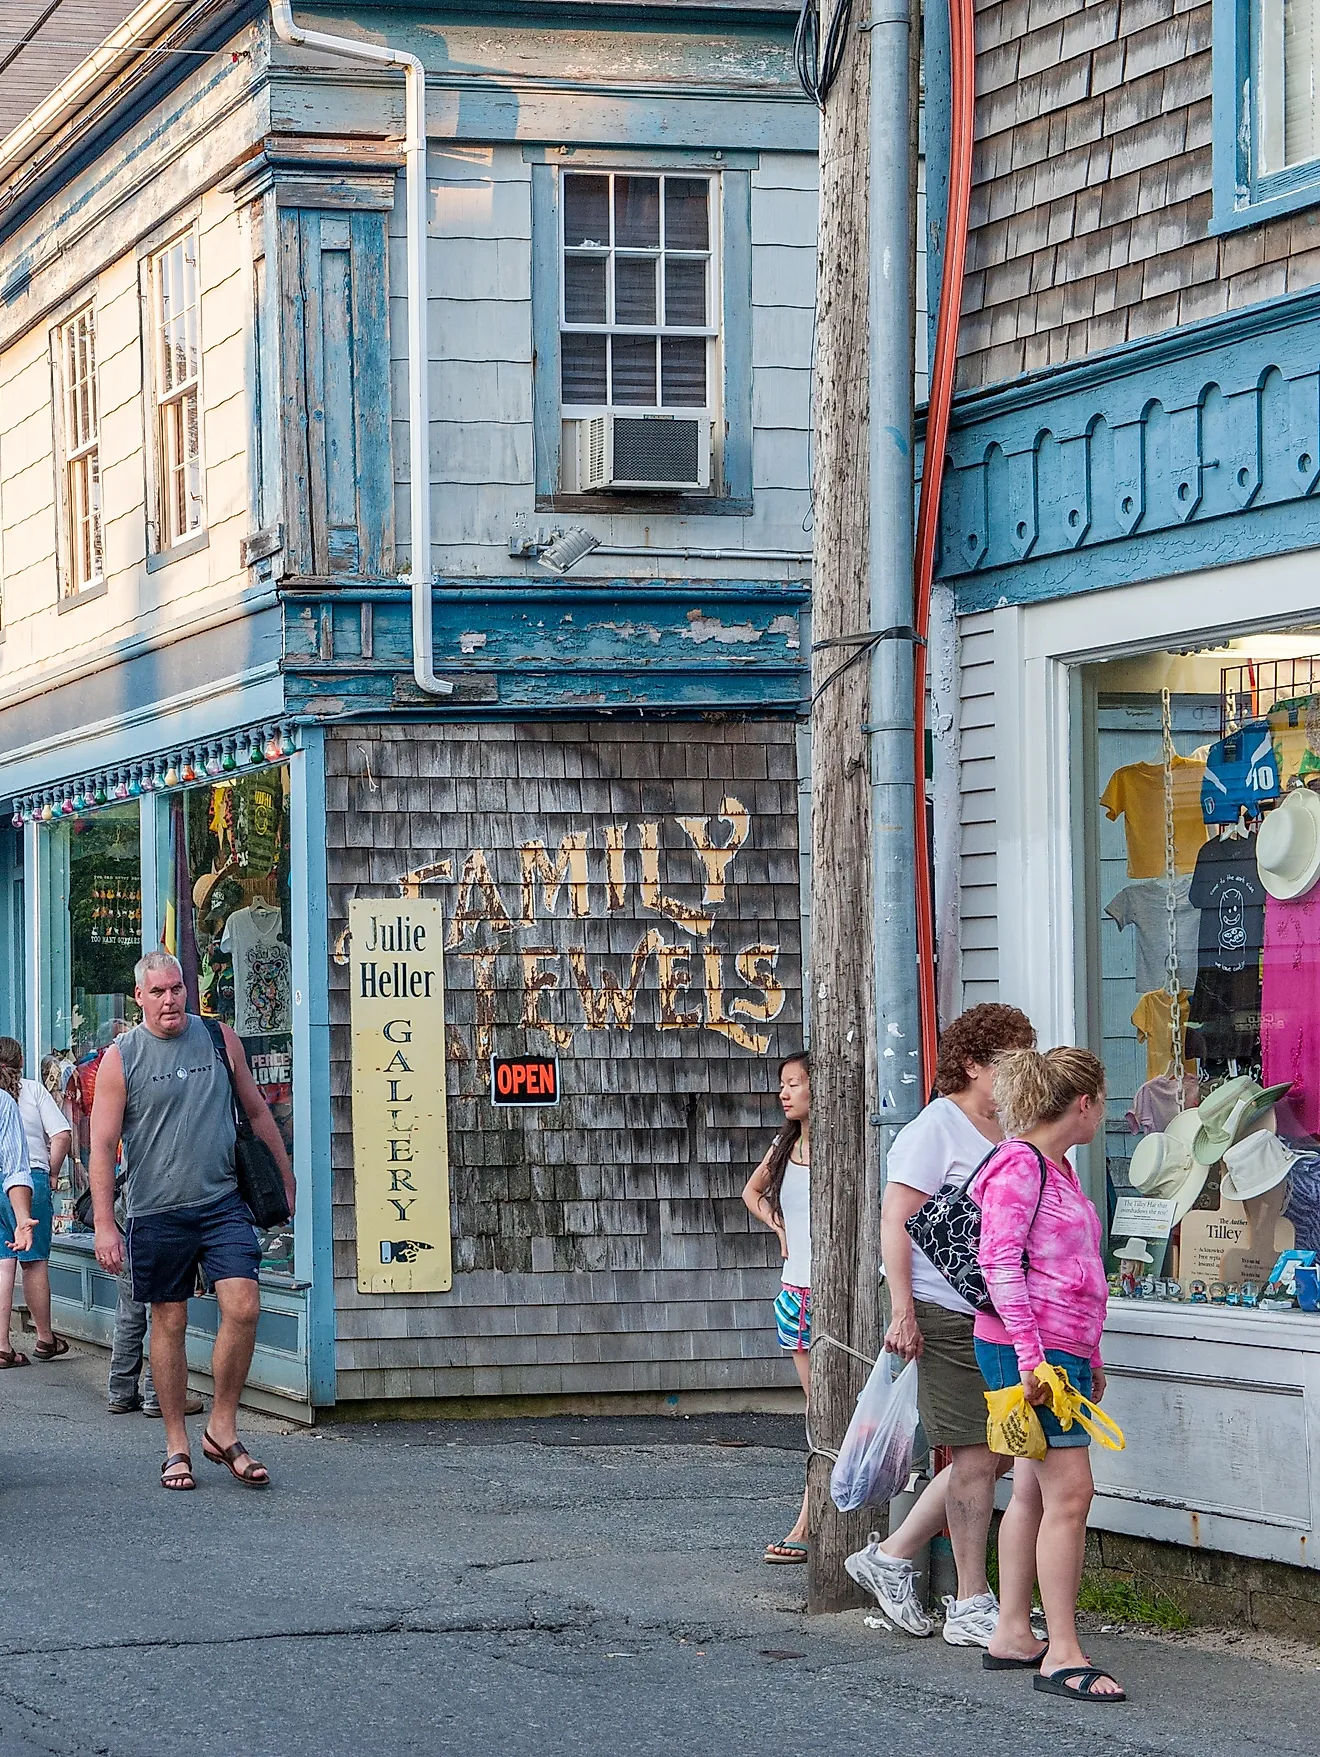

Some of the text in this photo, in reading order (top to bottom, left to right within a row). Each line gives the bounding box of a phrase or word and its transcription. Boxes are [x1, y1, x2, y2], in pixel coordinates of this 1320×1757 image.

[1252, 766, 1274, 791] 10
[91, 935, 100, 943] TOO
[365, 915, 426, 952] Julie
[359, 961, 436, 998] Heller
[251, 1053, 290, 1067] PEACE
[252, 1066, 291, 1085] LOVE
[497, 1064, 555, 1095] OPEN
[382, 1019, 418, 1222] GALLERY
[1206, 1224, 1242, 1244] Tilley
